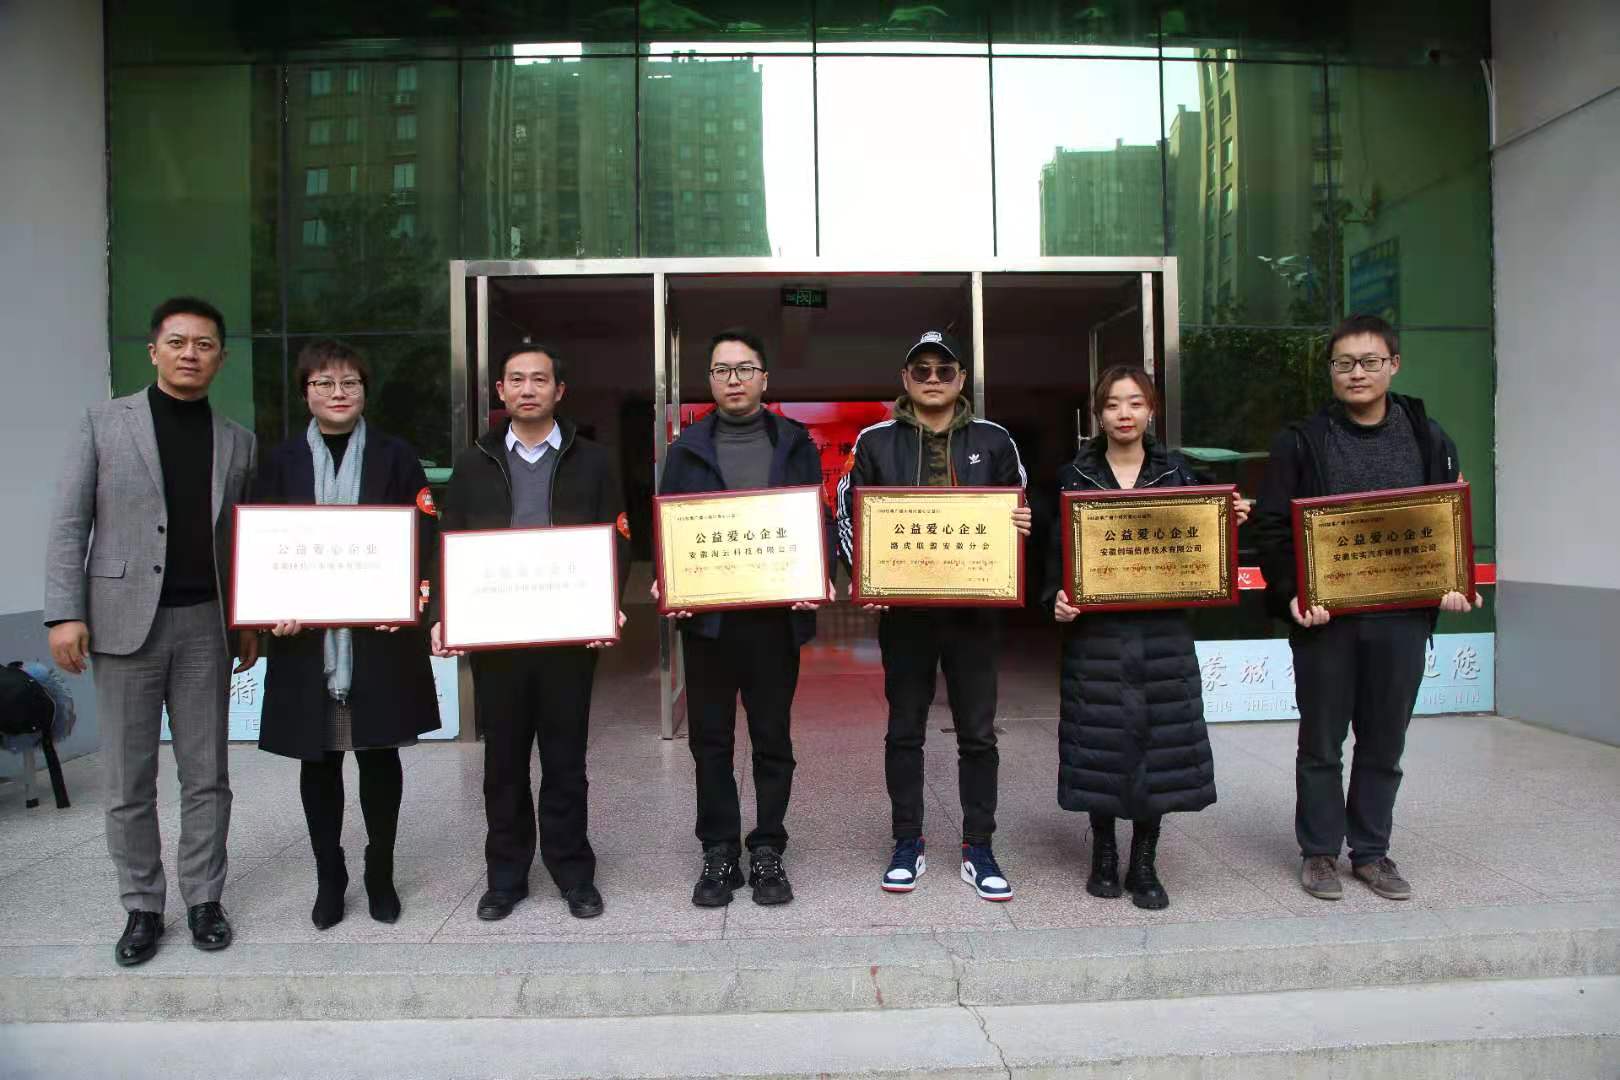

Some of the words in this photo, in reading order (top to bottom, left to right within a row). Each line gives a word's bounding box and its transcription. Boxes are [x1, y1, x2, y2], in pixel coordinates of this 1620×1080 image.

[695, 527, 788, 544] 公益爱心企业
[895, 523, 988, 536] 公益爱心企业
[1104, 526, 1199, 541] 公益爱心企业
[1336, 526, 1434, 547] 公益爱心企业
[1205, 697, 1233, 714] ENG
